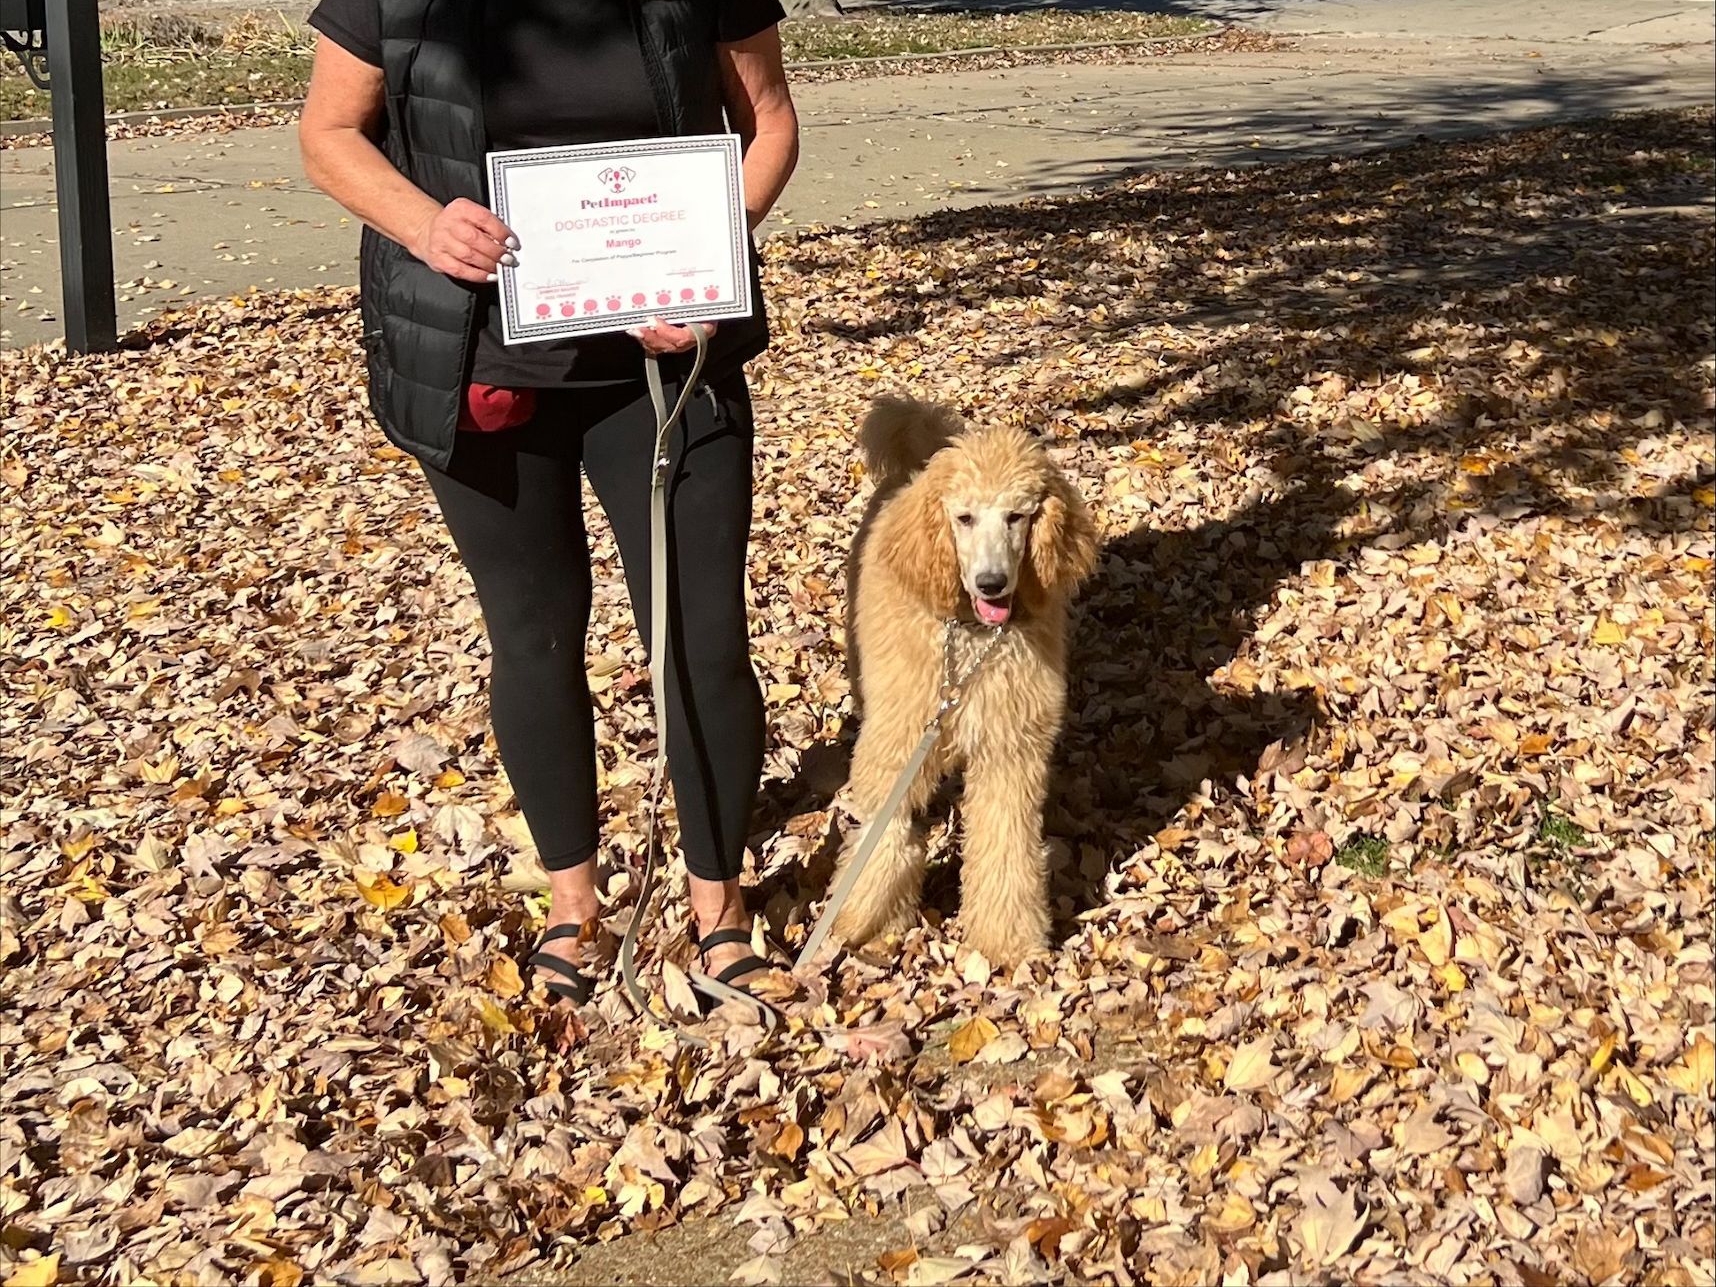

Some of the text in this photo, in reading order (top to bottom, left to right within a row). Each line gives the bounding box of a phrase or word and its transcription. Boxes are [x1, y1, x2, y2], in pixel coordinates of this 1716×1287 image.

[580, 193, 658, 209] PetImpact!
[554, 210, 686, 232] DOGTASTIC DEGREE
[606, 238, 642, 248] Mango
